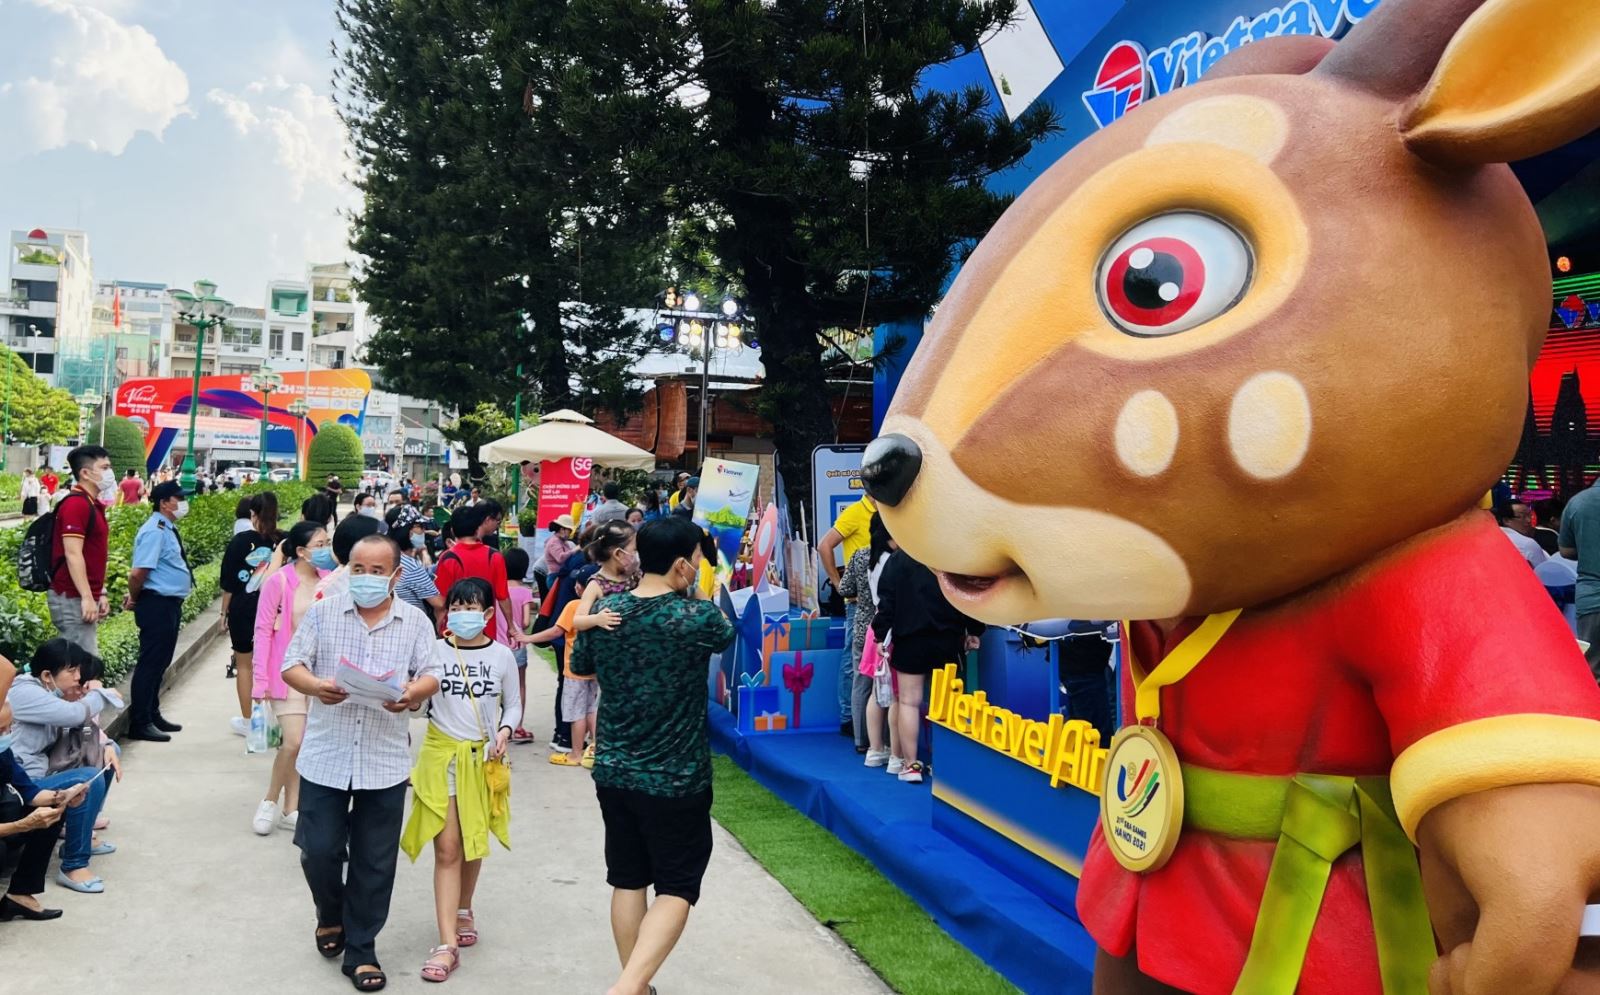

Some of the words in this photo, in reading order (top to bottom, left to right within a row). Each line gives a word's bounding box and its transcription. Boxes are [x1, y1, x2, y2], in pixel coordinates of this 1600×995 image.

[574, 457, 592, 471] SG
[443, 663, 479, 678] LOVE
[440, 678, 495, 700] PEACE
